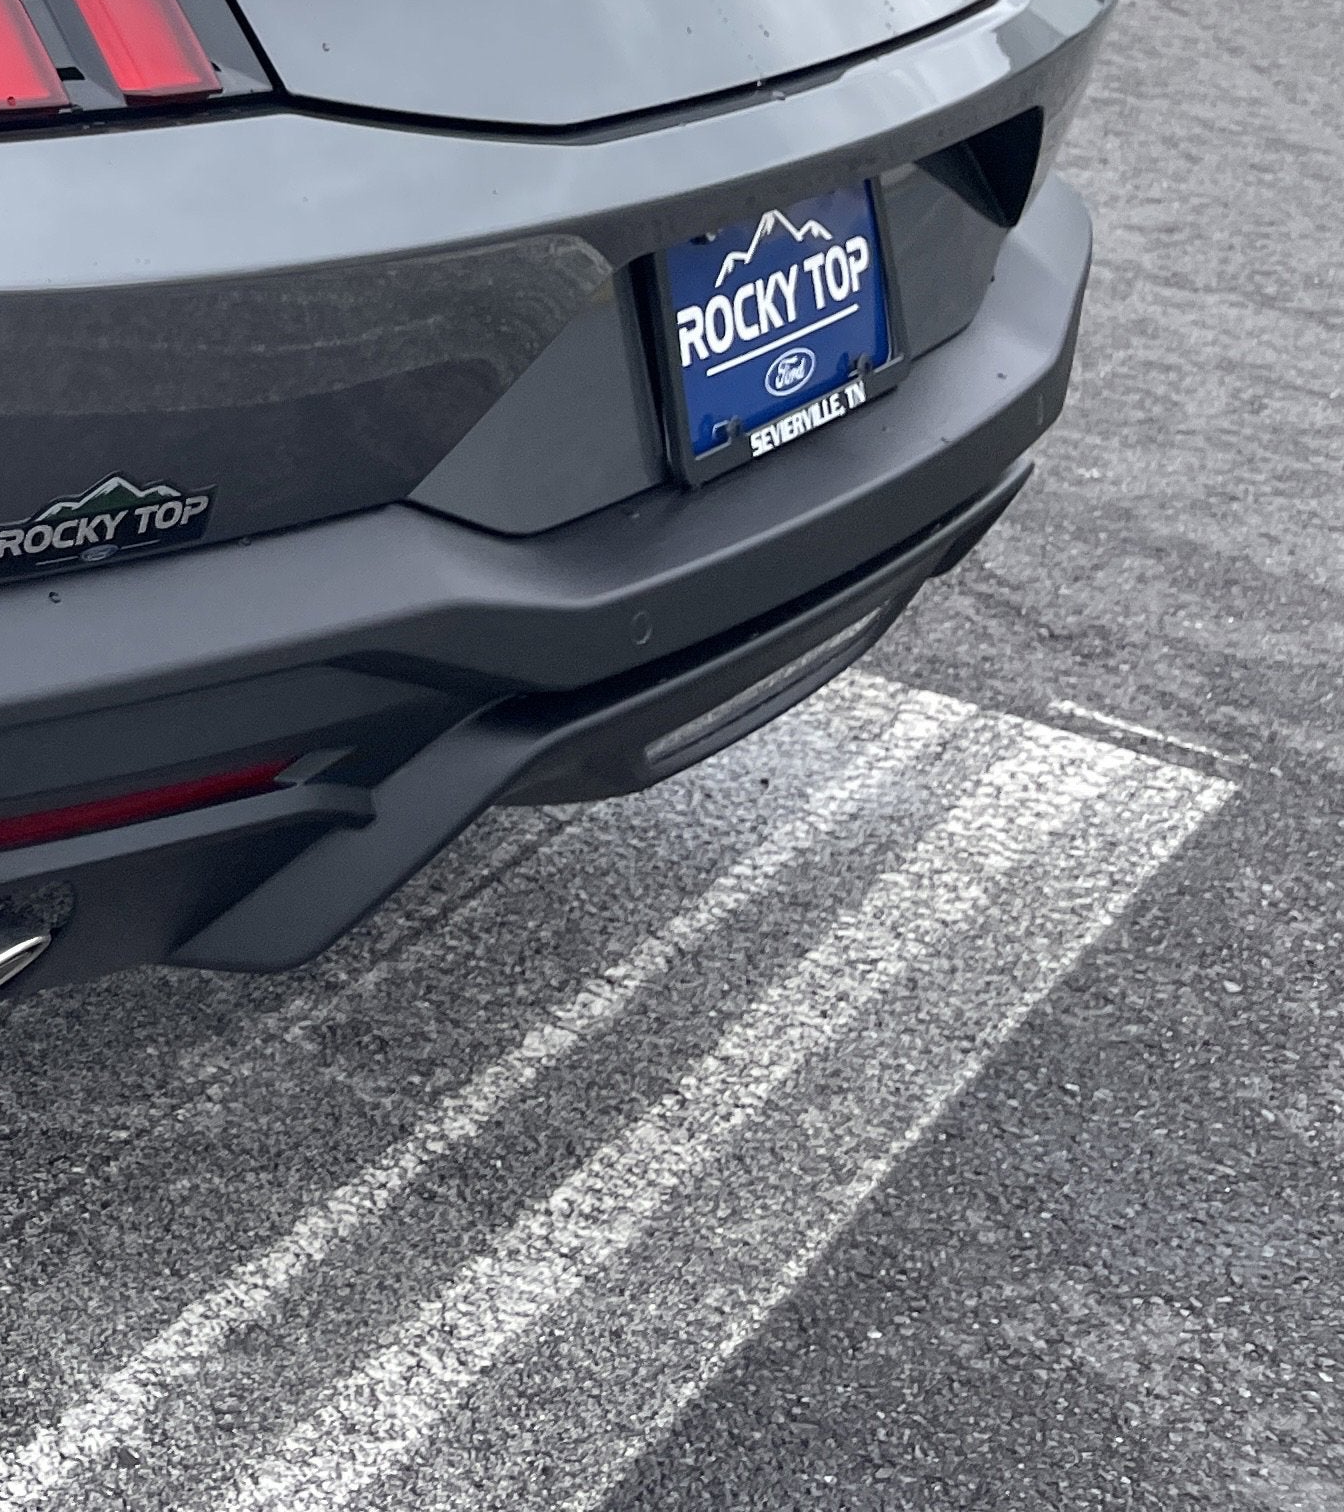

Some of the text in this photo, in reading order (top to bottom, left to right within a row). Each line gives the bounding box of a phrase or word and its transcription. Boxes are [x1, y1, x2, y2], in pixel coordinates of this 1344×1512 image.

[676, 235, 870, 367] ROCKY TOP
[775, 355, 807, 390] Ford
[750, 380, 867, 457] SEVIERVILLE, TN
[134, 495, 210, 534] TOP
